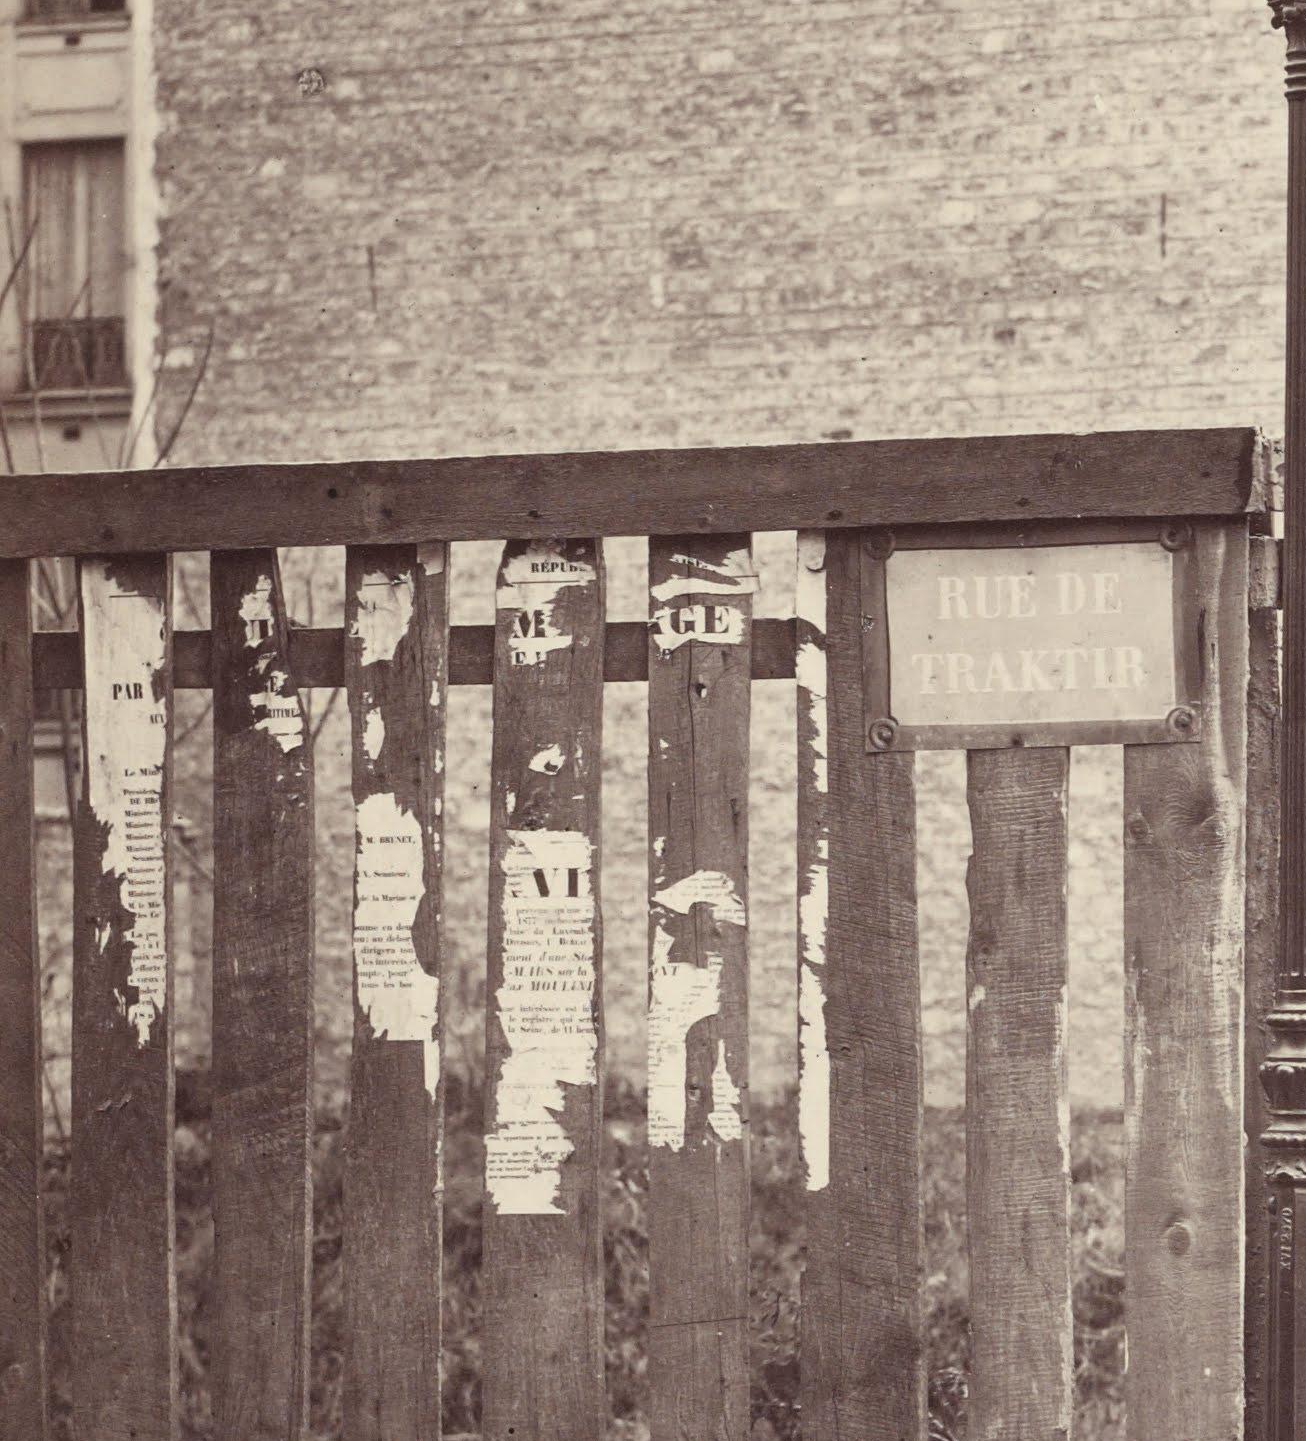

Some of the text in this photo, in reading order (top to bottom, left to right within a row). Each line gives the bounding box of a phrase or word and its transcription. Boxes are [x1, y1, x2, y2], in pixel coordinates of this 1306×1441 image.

[937, 571, 1123, 620] RUE DE
[111, 682, 144, 700] PAR
[911, 645, 1147, 694] TRAKTIR
